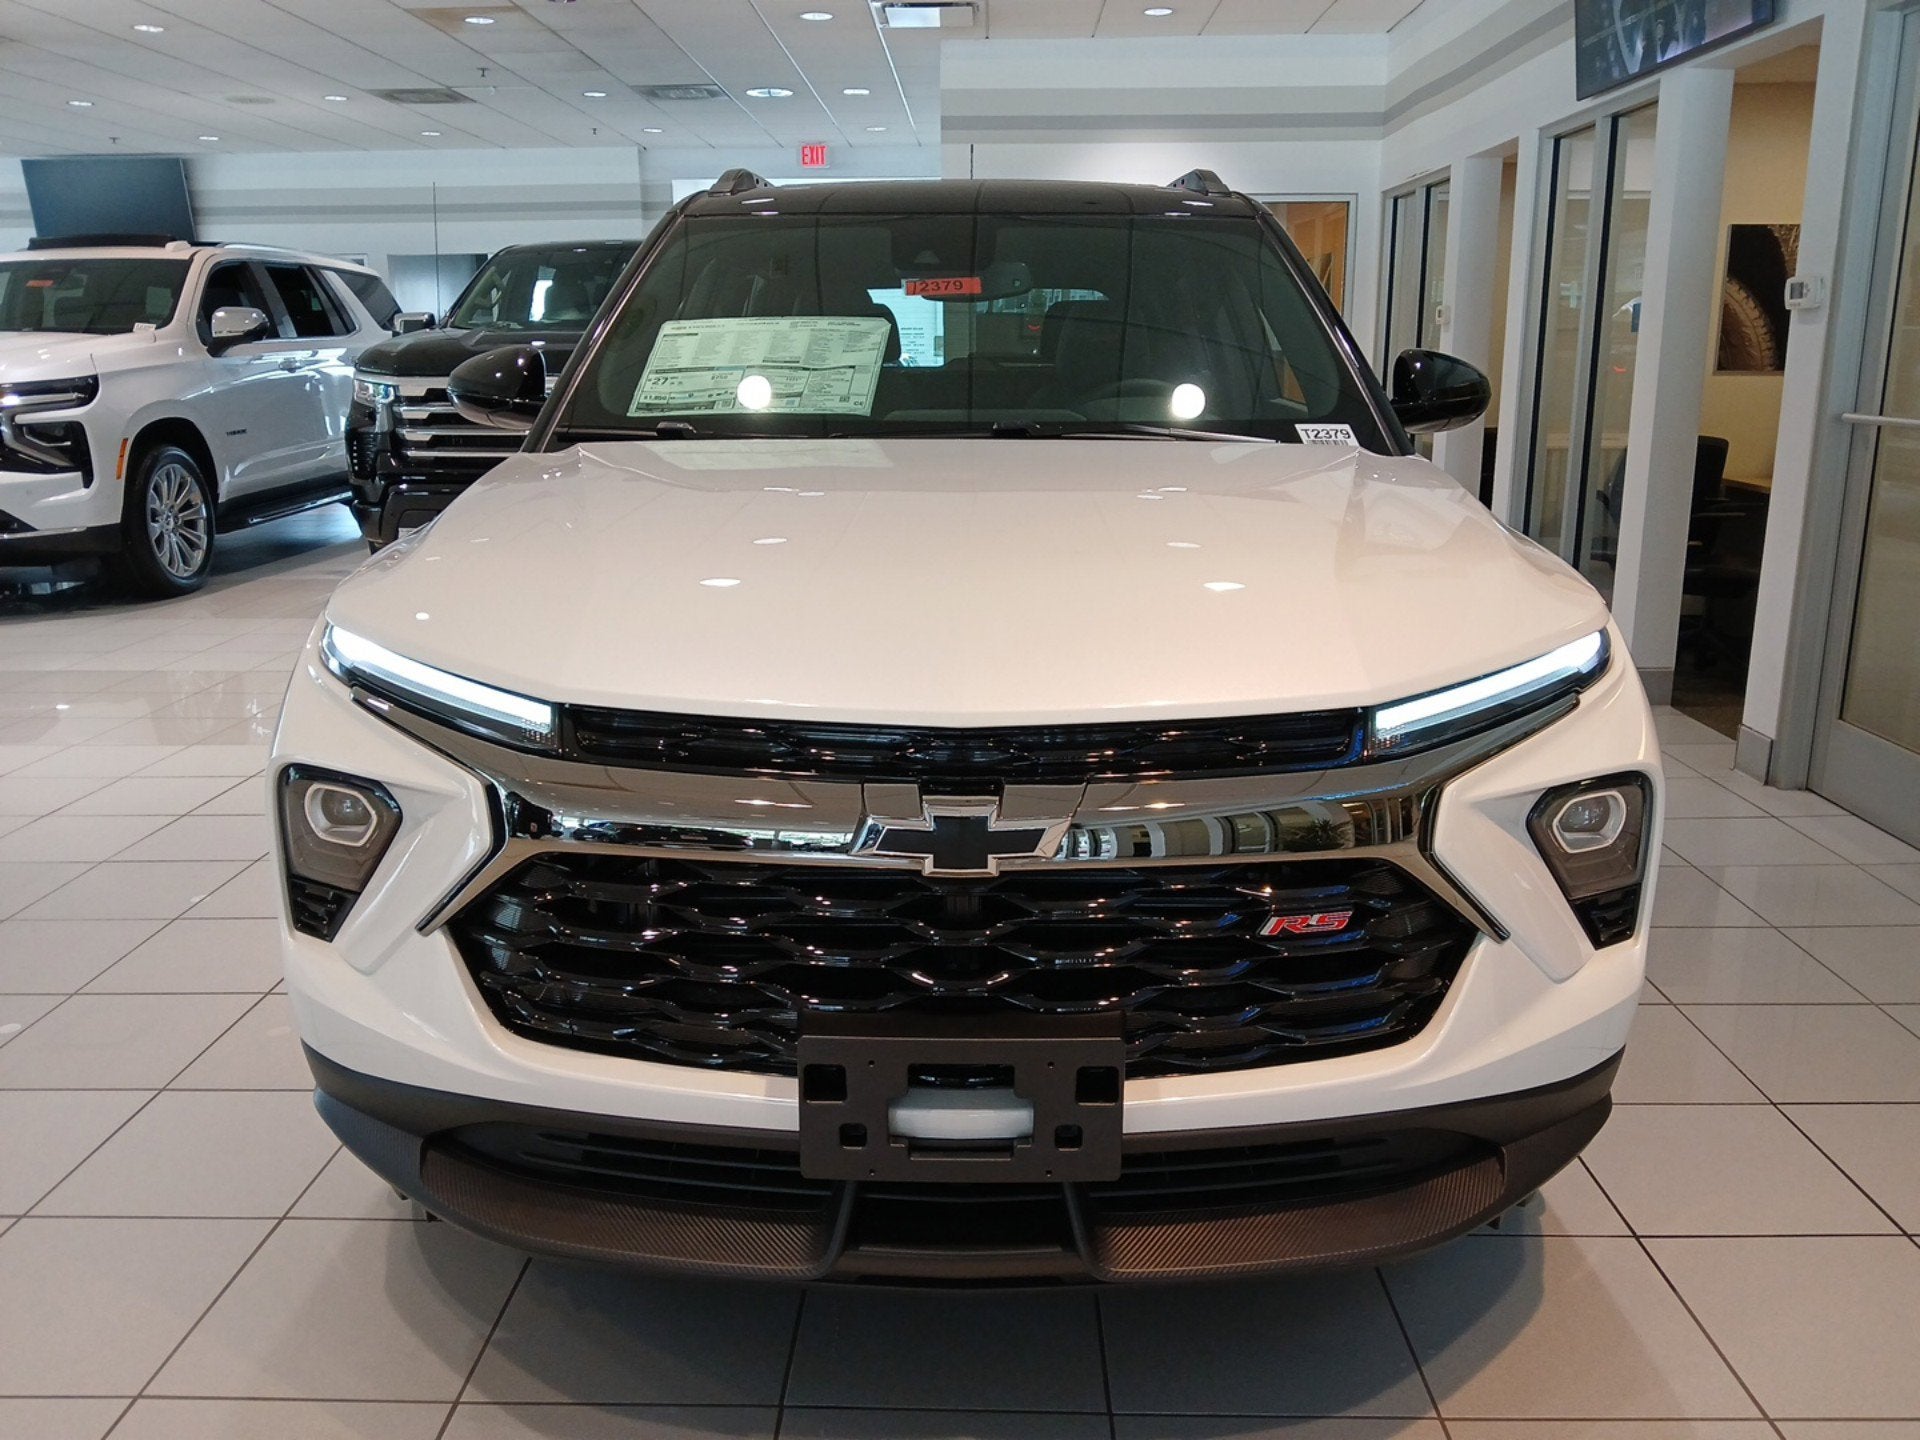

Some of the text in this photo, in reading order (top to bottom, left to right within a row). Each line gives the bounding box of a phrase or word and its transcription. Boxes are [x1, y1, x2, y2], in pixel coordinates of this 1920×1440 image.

[802, 145, 826, 165] EXIT
[1301, 428, 1351, 439] T2379
[1260, 911, 1353, 935] RS
